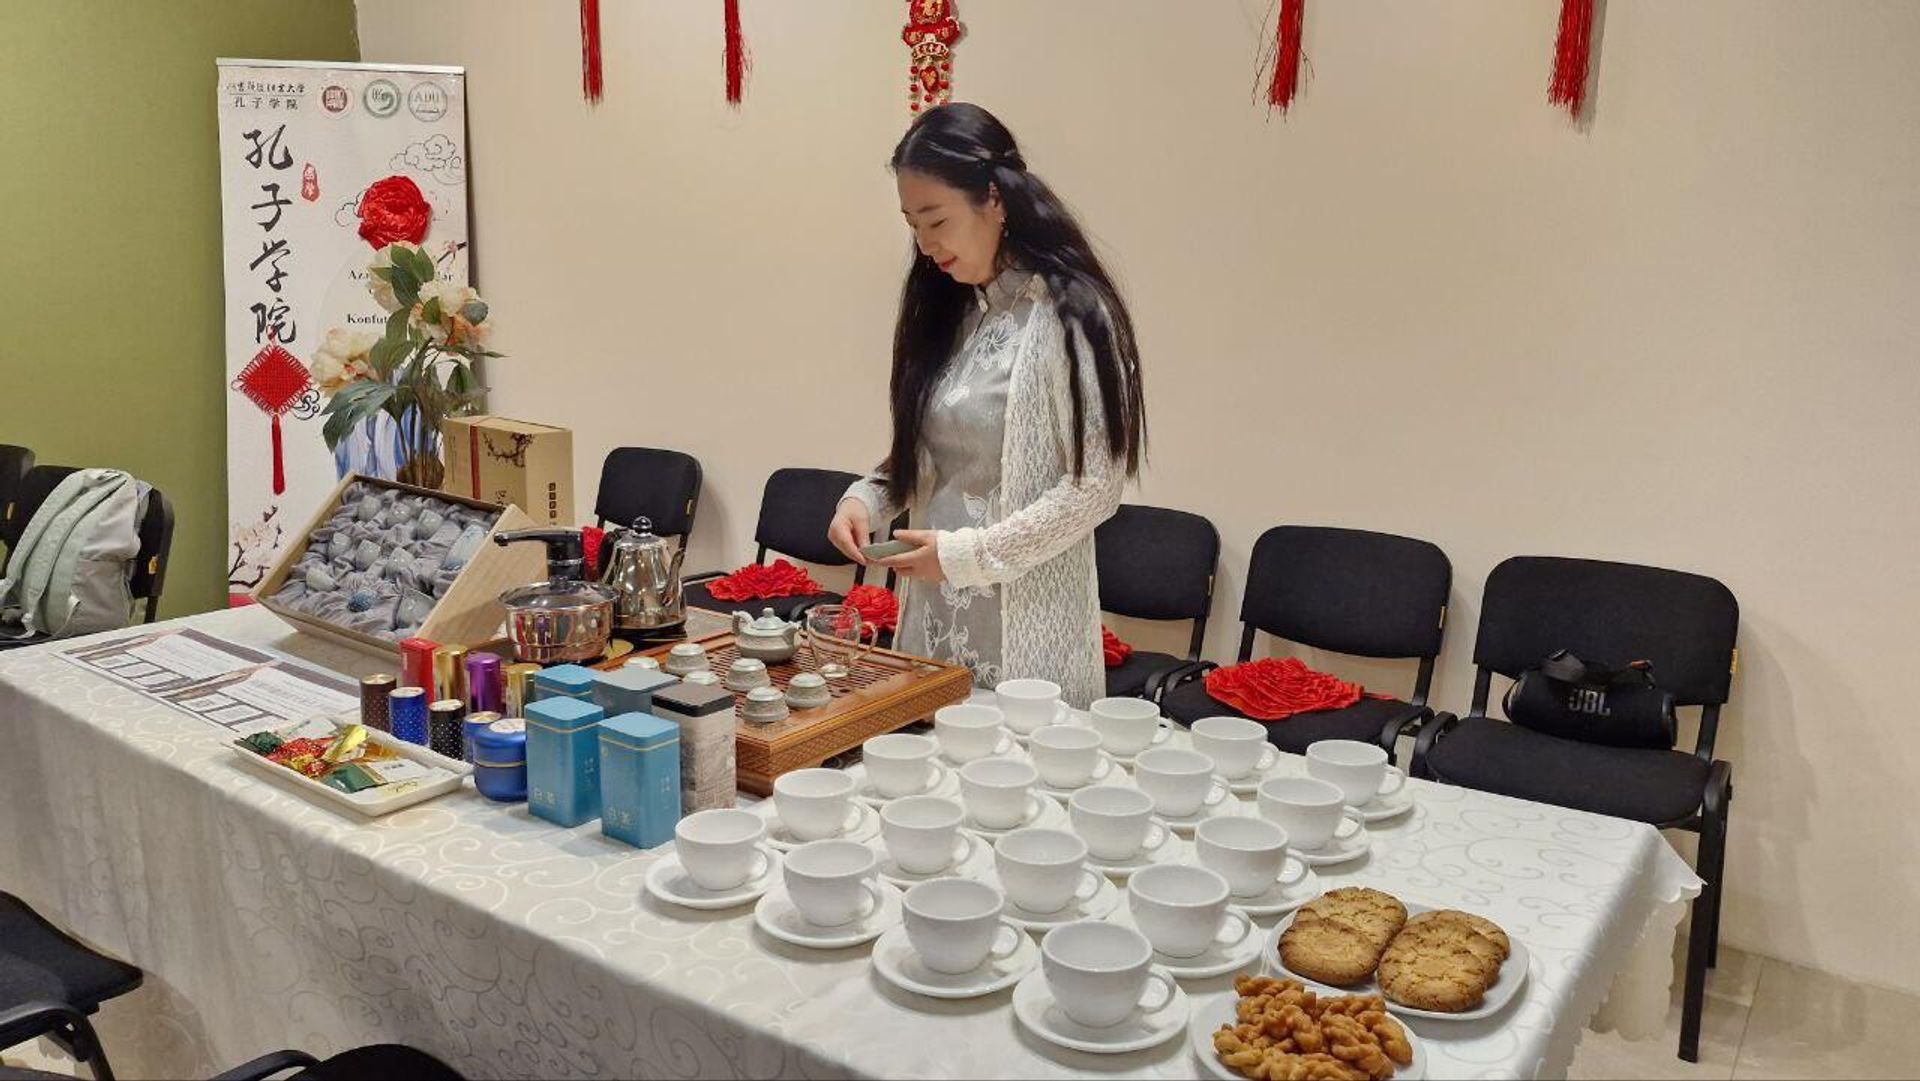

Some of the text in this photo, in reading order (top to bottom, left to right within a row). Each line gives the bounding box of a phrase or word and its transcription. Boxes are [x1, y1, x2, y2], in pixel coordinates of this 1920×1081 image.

[235, 96, 298, 110] 孔子学院
[414, 90, 439, 103] ADU
[243, 124, 296, 344] 孔子学院
[1569, 690, 1610, 716] JBL
